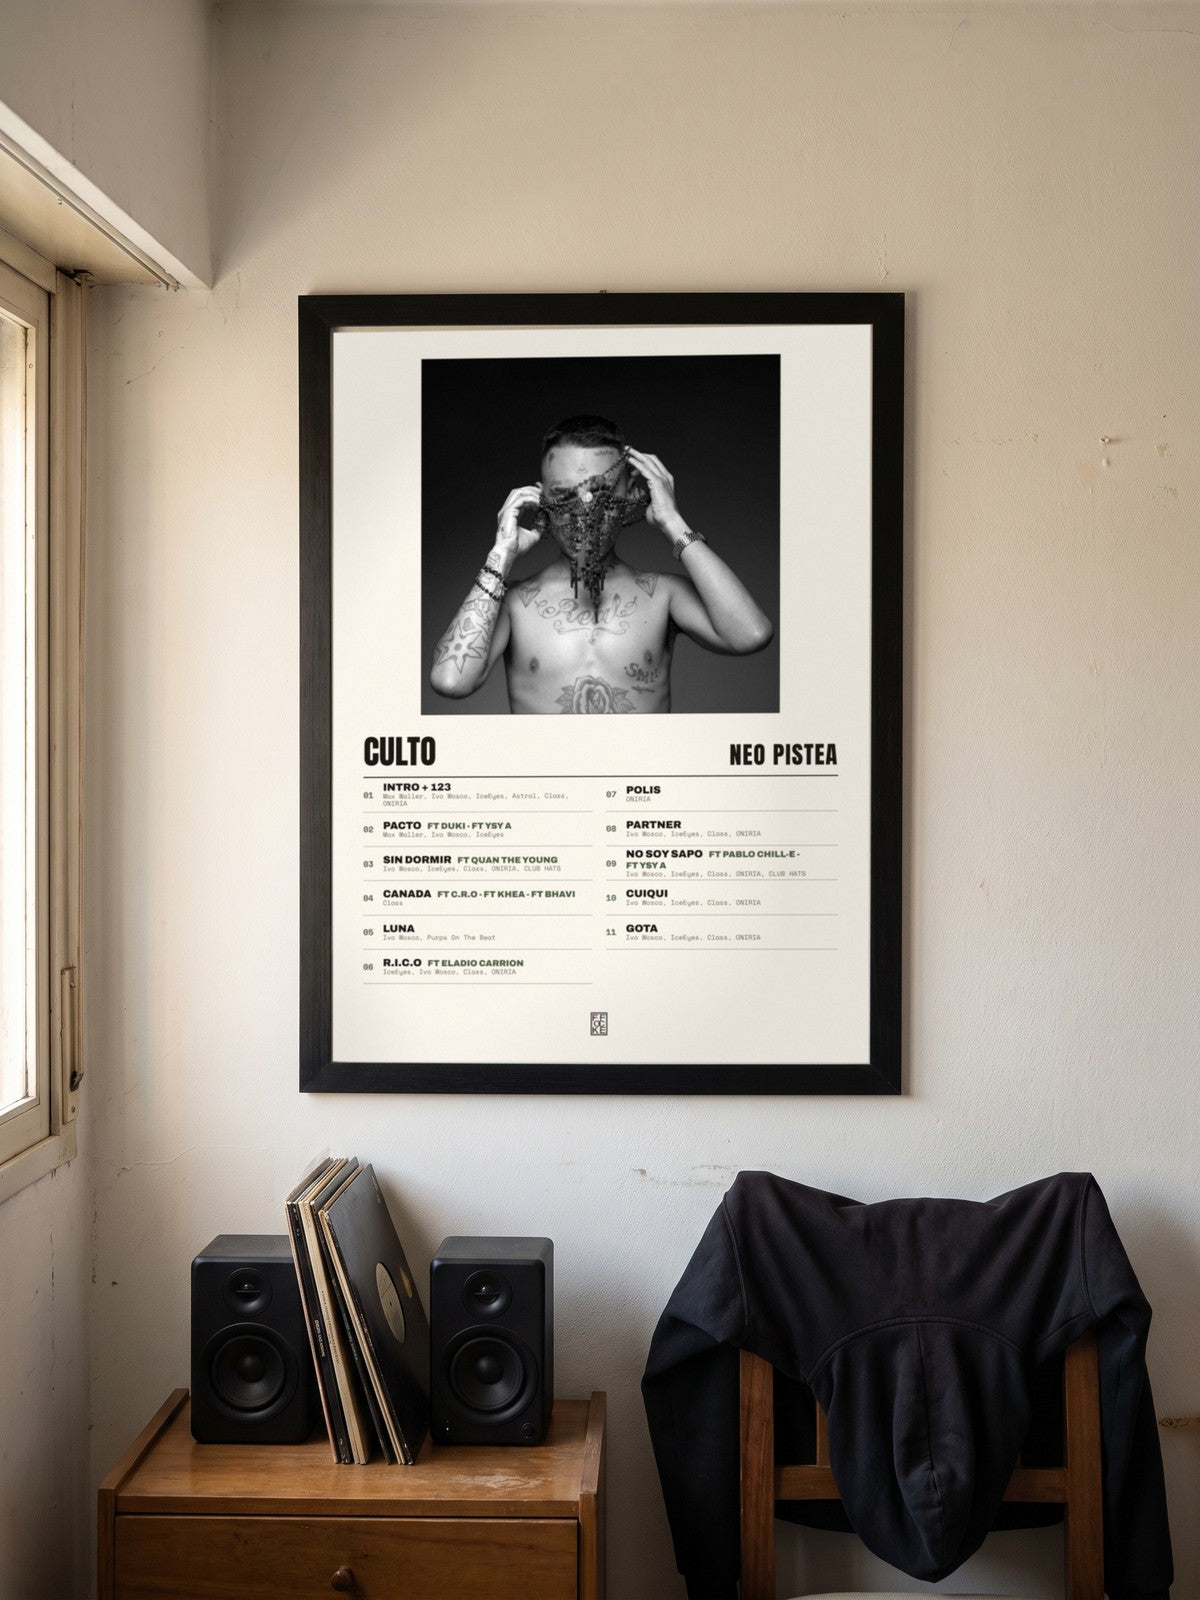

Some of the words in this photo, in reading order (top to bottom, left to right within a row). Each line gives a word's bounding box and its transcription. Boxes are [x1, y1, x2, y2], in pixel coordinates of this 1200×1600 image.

[364, 736, 435, 766] CULTO
[730, 744, 765, 765] NEO
[773, 744, 837, 765] PISTEA
[384, 783, 419, 791] INTRO
[431, 783, 451, 791] 123
[627, 786, 661, 794] POLIS
[627, 821, 681, 829] PARTNER
[476, 831, 504, 839] IceEyes
[627, 850, 643, 858] NO
[646, 850, 669, 858] SOY
[671, 850, 703, 858] SAPO
[383, 856, 402, 864] SIN
[405, 856, 451, 864] DORMIR
[383, 890, 431, 898] CANADA
[626, 890, 668, 899] CUIQUI
[626, 924, 658, 932] GOTA
